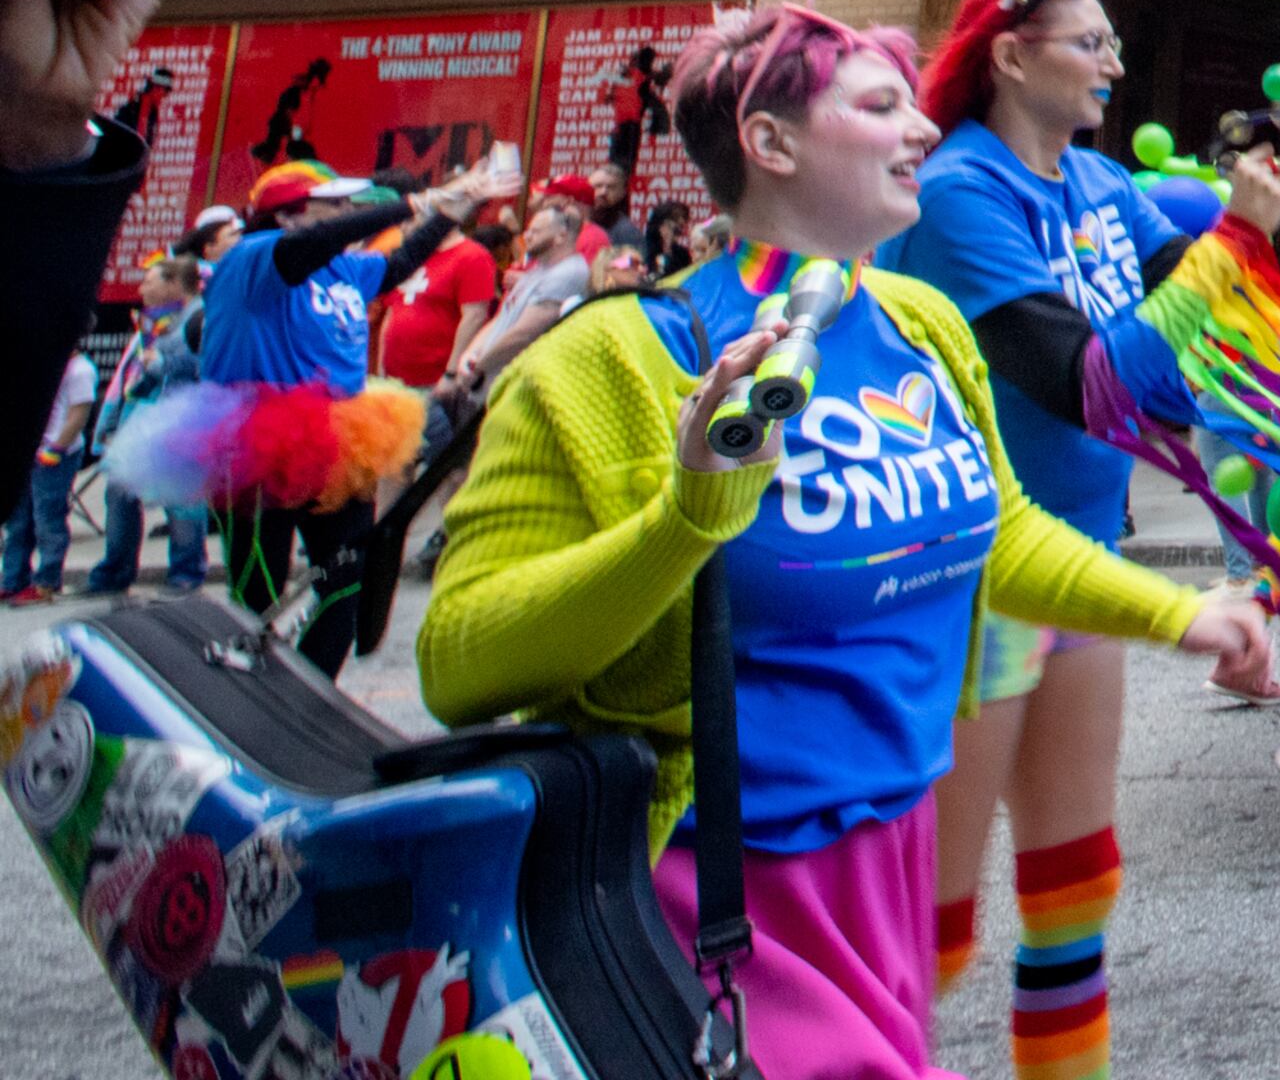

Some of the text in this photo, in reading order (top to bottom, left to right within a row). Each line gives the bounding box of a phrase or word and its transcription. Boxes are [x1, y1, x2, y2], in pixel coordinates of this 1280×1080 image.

[342, 37, 371, 59] THE
[372, 35, 424, 57] 4-TIME
[469, 30, 522, 53] AWARD
[378, 54, 519, 82] WINNING MUSICAL!
